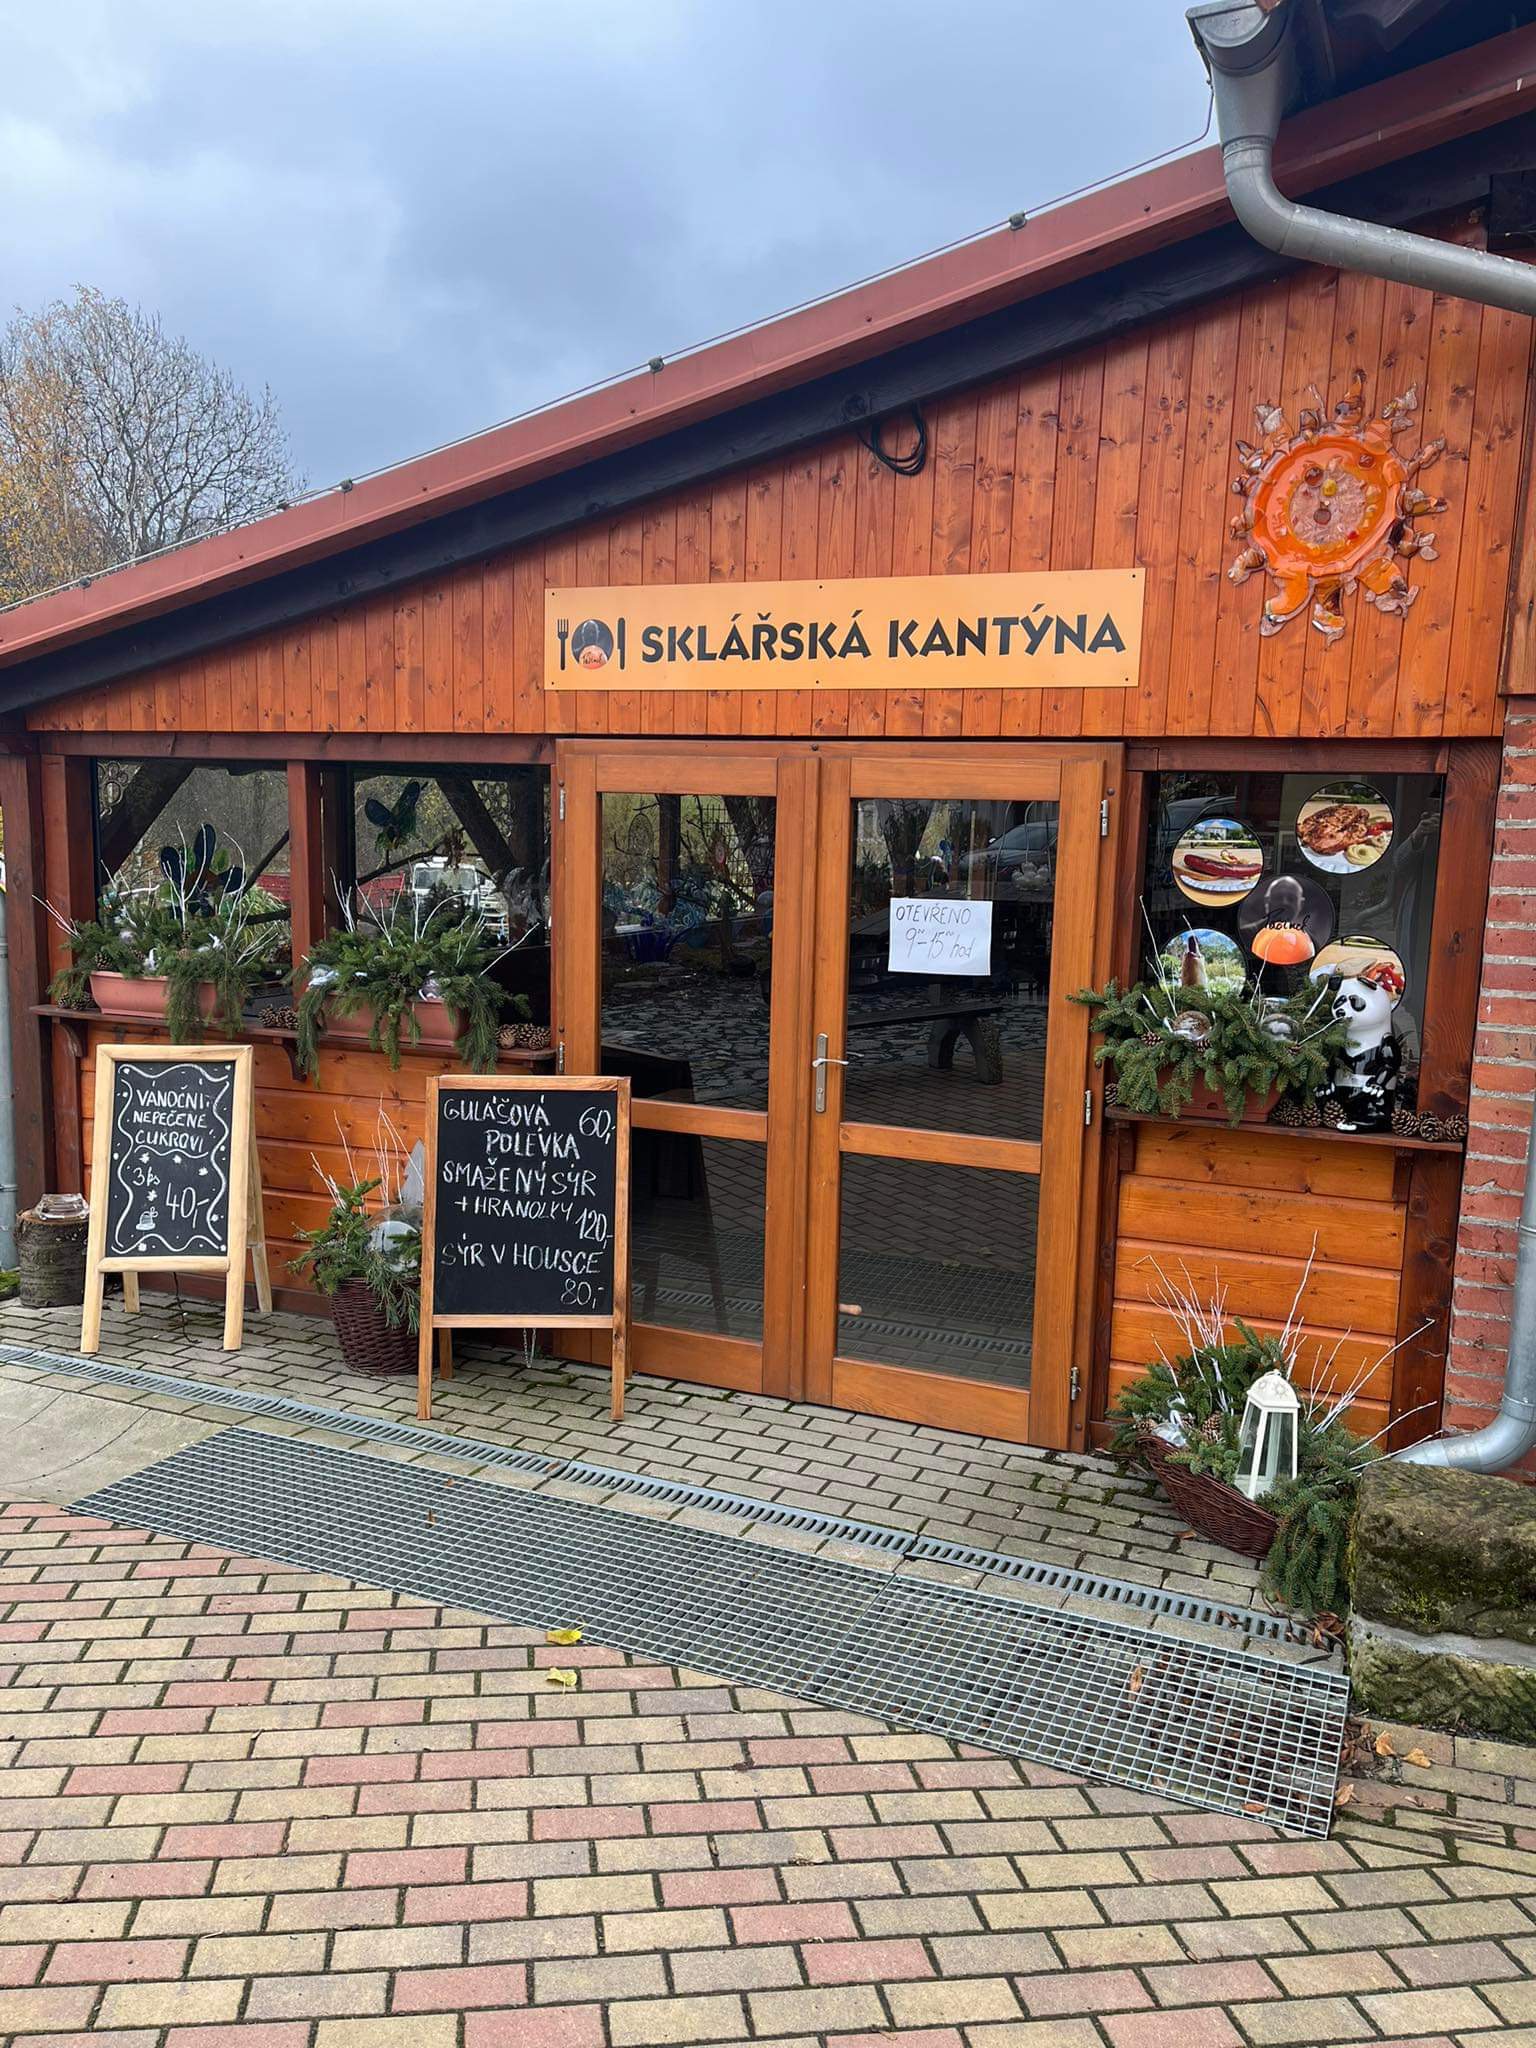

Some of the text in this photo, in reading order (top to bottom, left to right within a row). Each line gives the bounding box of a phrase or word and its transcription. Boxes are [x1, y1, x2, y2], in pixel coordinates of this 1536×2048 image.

[641, 603, 1127, 664] SKLÁŘSKÁ KANTÝNA
[896, 903, 972, 925] OTEVŘENO
[136, 1078, 204, 1110] VÁNOČNÍ
[443, 1094, 551, 1127] GULÁŠOVÁ
[442, 1157, 597, 1197] SMAŽENÝ SÝR
[575, 1207, 614, 1250] 120,-
[440, 1232, 604, 1276] SÝR V HOUSCE
[560, 1278, 605, 1310] 80,-
